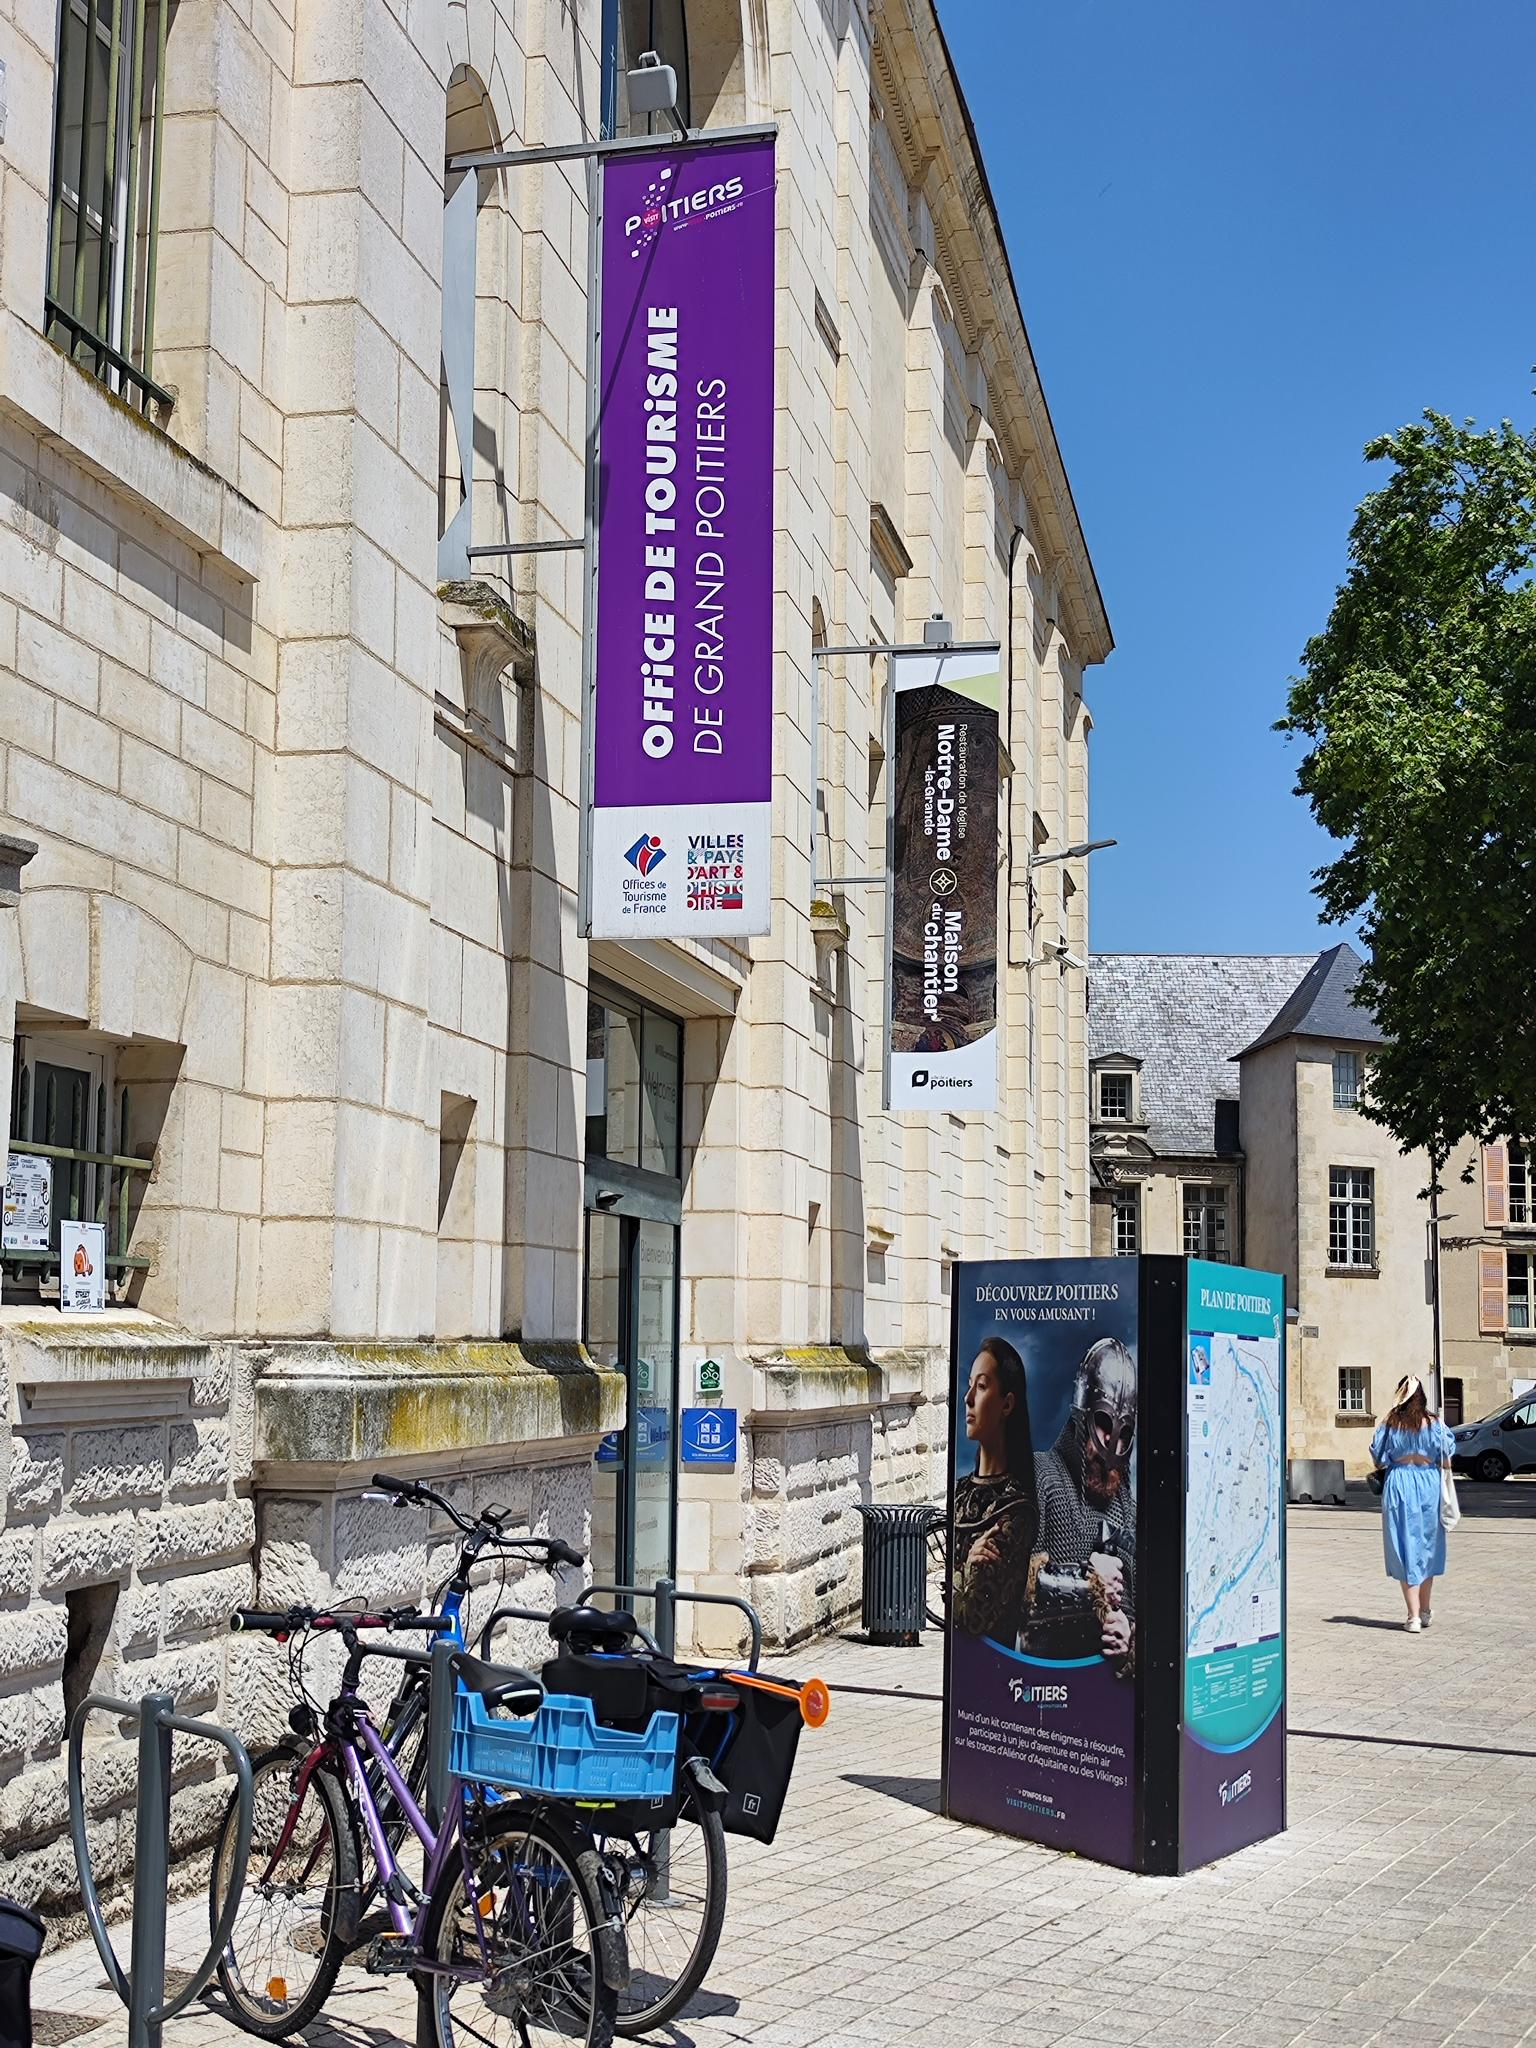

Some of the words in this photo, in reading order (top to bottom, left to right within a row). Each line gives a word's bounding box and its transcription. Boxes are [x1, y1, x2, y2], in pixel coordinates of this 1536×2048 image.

[695, 379, 726, 538] POITIERS
[645, 545, 676, 601] DE
[694, 551, 725, 695] GRAND
[693, 707, 723, 755] DE
[958, 723, 968, 790] Restauration
[936, 724, 955, 861] Notre-Dame
[957, 790, 966, 804] de
[687, 834, 744, 849] VILLES
[704, 849, 744, 864] PAYS
[622, 879, 656, 890] Offices
[657, 881, 667, 889] de
[623, 891, 667, 901] Tourisme
[622, 906, 632, 914] de
[633, 904, 667, 914] France
[931, 902, 943, 921] du
[944, 911, 963, 992] Maison
[924, 921, 943, 1022] chantier
[930, 1076, 973, 1090] poitiers
[976, 1282, 1053, 1302] DÉCOUVREZ
[1055, 1283, 1119, 1301] POITIERS
[1200, 1288, 1225, 1309] PLAN
[1225, 1292, 1237, 1311] DE
[1237, 1294, 1271, 1315] POITIERS
[995, 1308, 1008, 1320] EN
[1011, 1308, 1036, 1321] VOUS
[1038, 1307, 1091, 1321] AMUSANT
[1014, 1685, 1068, 1702] POITIERS
[957, 1709, 975, 1721] Muni
[975, 1713, 990, 1725] d'un
[991, 1716, 1000, 1728] kit
[1000, 1720, 1036, 1736] contenant
[1036, 1727, 1050, 1739] des
[1051, 1730, 1083, 1746] énigmes
[1083, 1737, 1089, 1748] à
[1089, 1740, 1126, 1758] résoudre,
[969, 1726, 1001, 1741] participez
[1002, 1732, 1007, 1743] à
[1007, 1736, 1018, 1745] un
[1018, 1736, 1030, 1749] jeu
[1030, 1740, 1068, 1757] d'aventure
[1069, 1750, 1079, 1760] en
[1080, 1752, 1099, 1765] plein
[1100, 1756, 1111, 1767] air
[955, 1736, 966, 1746] sur
[966, 1737, 976, 1749] les
[976, 1741, 996, 1754] traces
[997, 1745, 1027, 1762] d'Aliénor
[1027, 1753, 1068, 1771] d'Aquitaine
[1069, 1765, 1080, 1775] ou
[1080, 1766, 1094, 1778] des
[1095, 1769, 1124, 1787] Vikings
